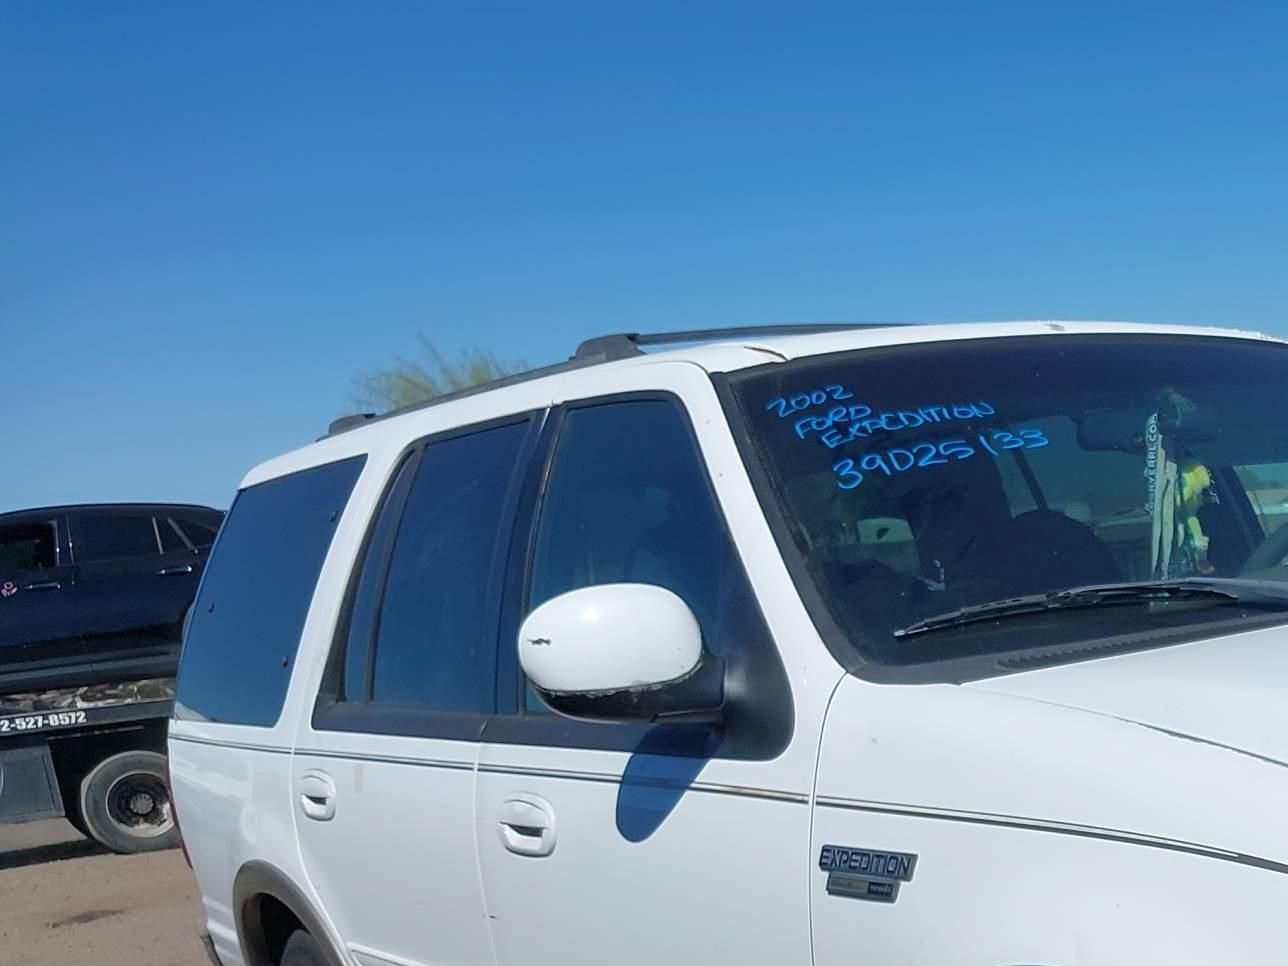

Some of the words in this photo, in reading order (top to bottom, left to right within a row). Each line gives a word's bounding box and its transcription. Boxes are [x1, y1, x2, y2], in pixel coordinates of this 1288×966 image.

[768, 383, 854, 418] 2002
[794, 403, 872, 440] FORD
[820, 848, 912, 877] EXPEDITION
